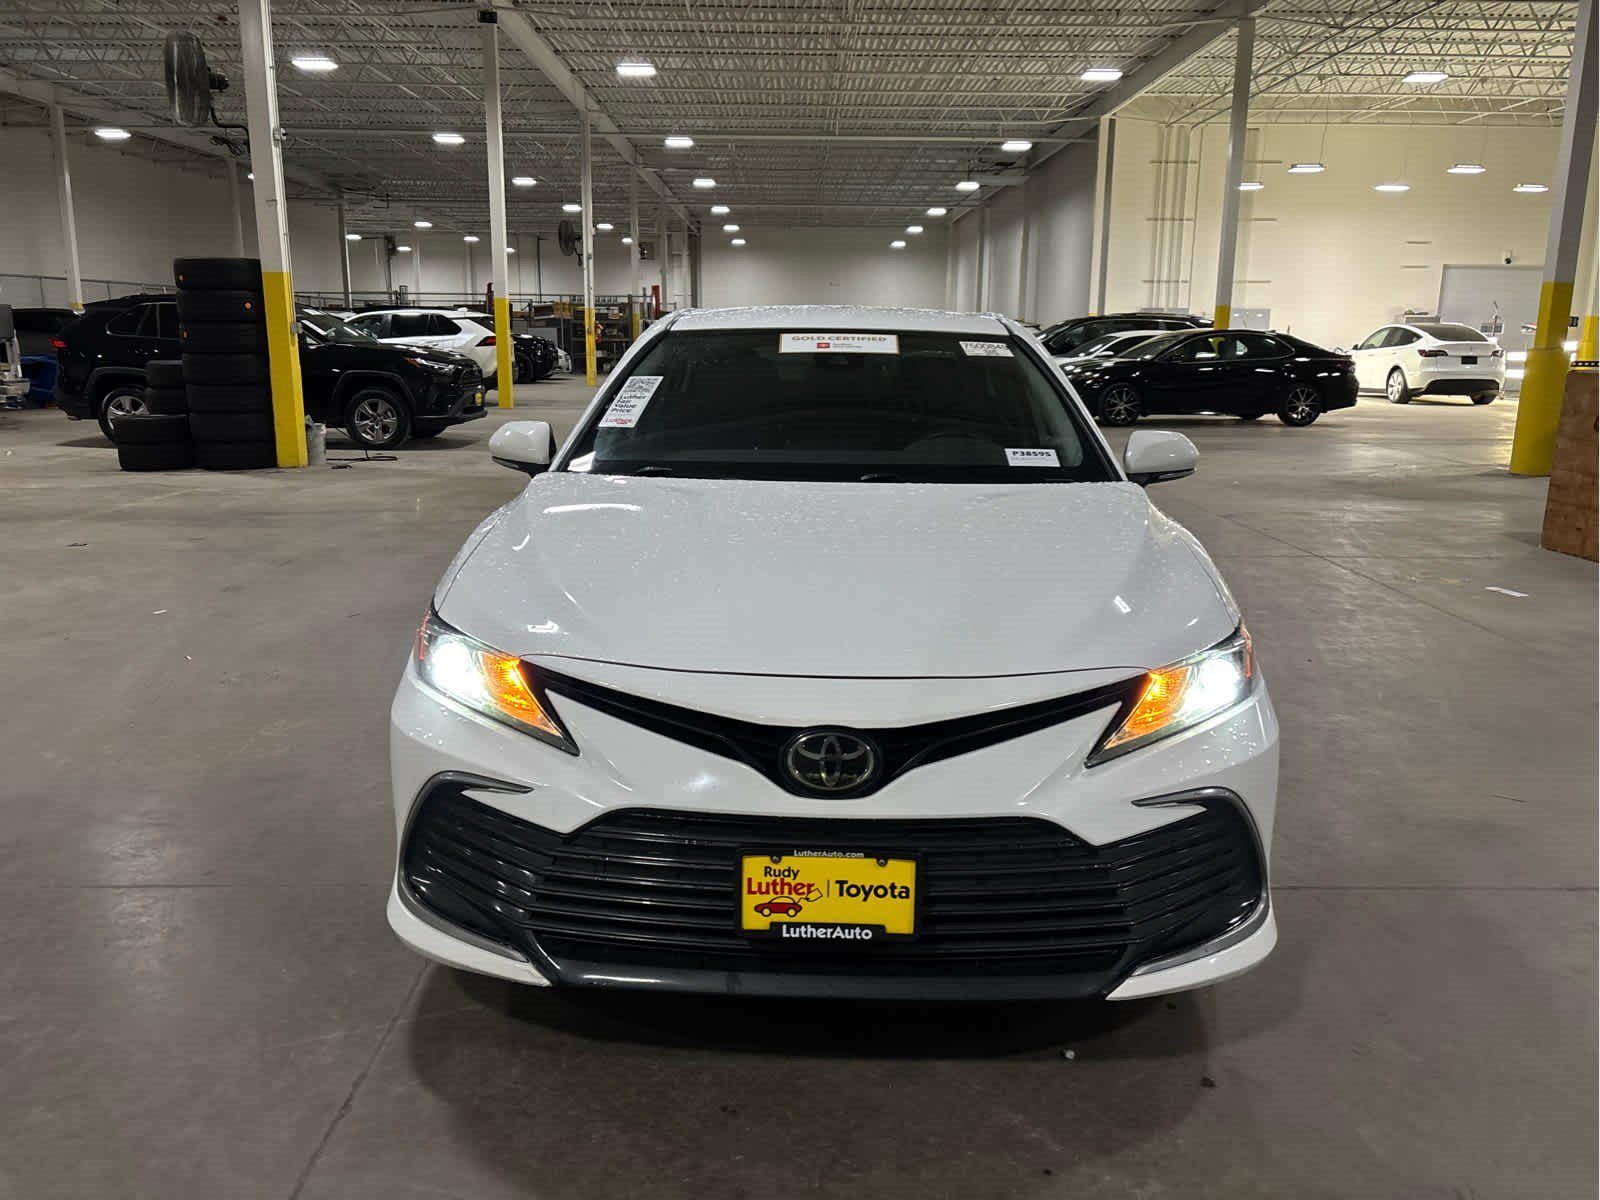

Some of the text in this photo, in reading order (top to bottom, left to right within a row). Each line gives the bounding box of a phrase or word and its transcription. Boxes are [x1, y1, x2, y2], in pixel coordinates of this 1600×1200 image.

[828, 335, 887, 343] CERTIFIED
[793, 849, 865, 858] LutherAuto.com
[763, 866, 800, 881] Rudy
[746, 877, 911, 902] Luther Toyota
[781, 924, 873, 940] LutherAuto
